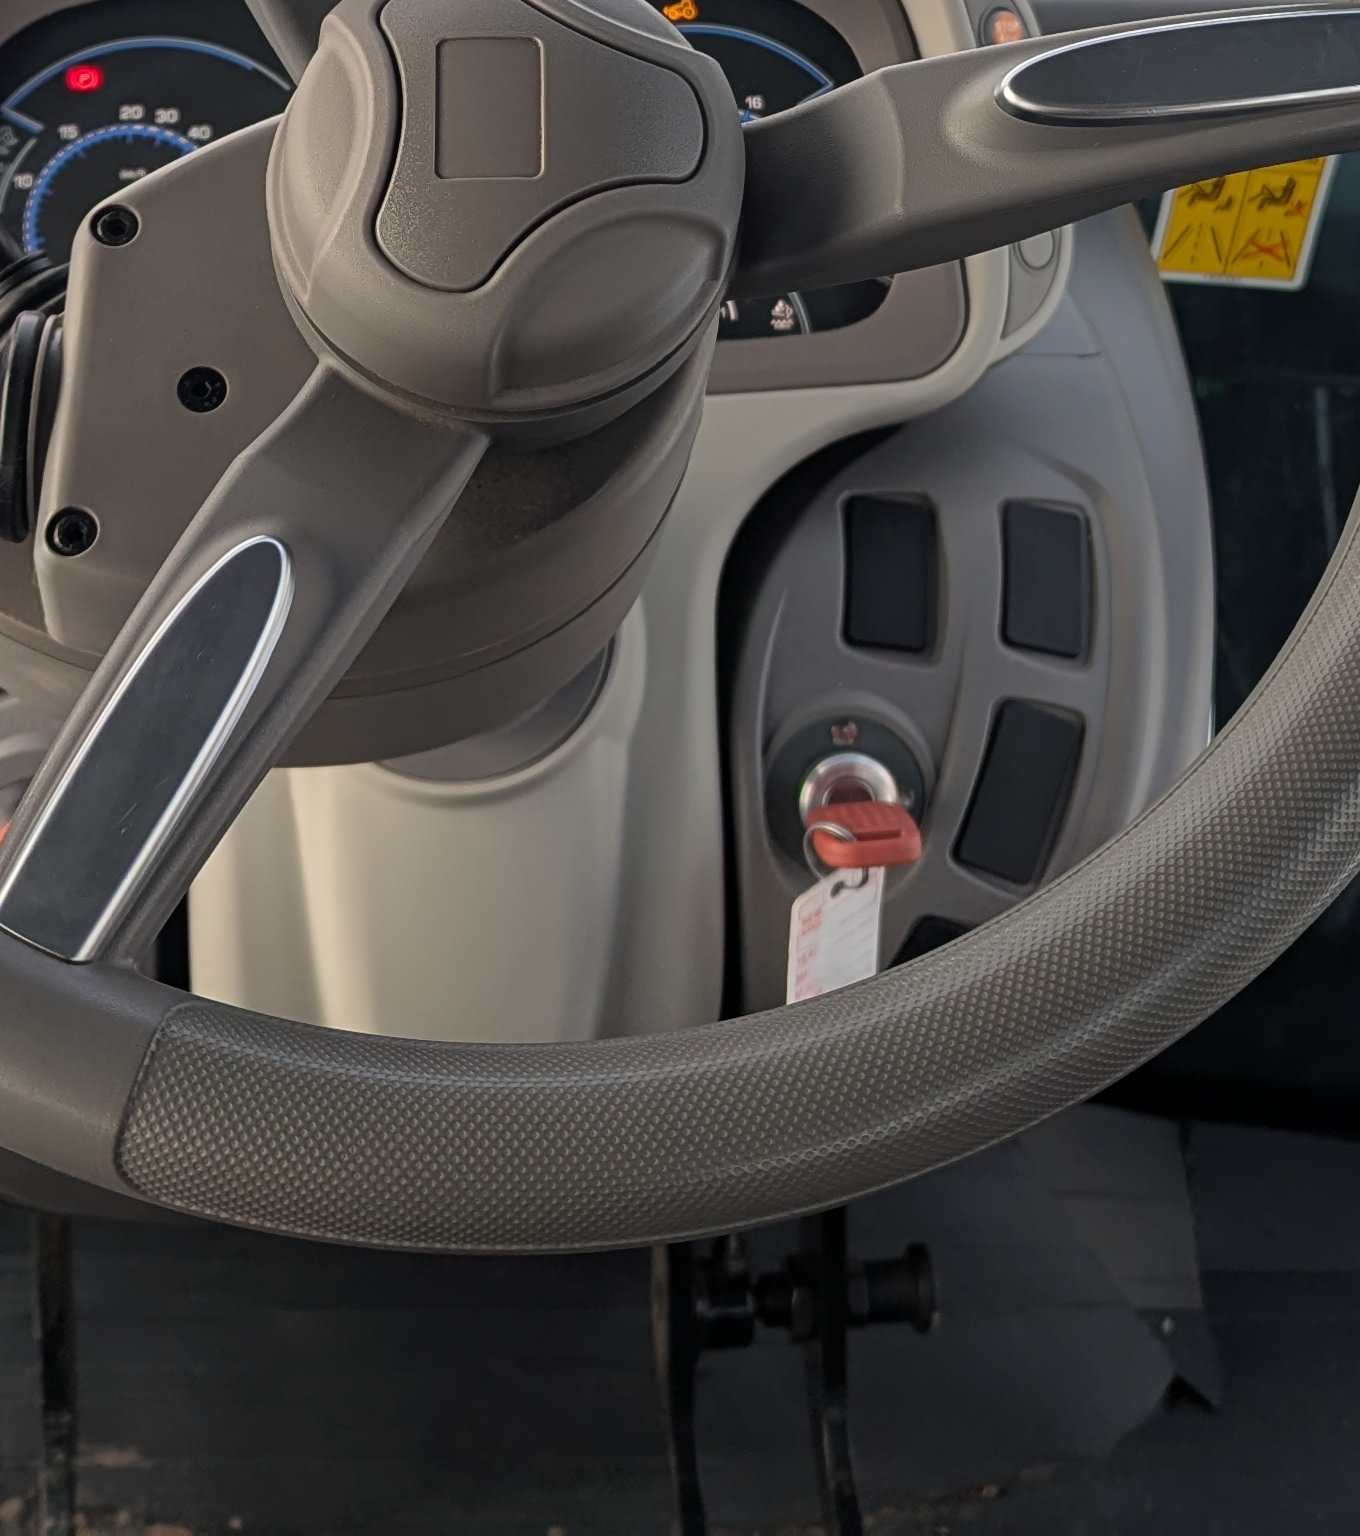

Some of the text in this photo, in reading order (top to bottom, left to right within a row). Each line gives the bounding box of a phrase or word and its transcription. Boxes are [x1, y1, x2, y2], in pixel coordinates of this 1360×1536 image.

[744, 95, 763, 110] 16
[118, 104, 145, 121] 20
[154, 107, 181, 124] 30
[57, 124, 80, 140] 15
[187, 125, 213, 140] 40
[13, 173, 34, 190] 10
